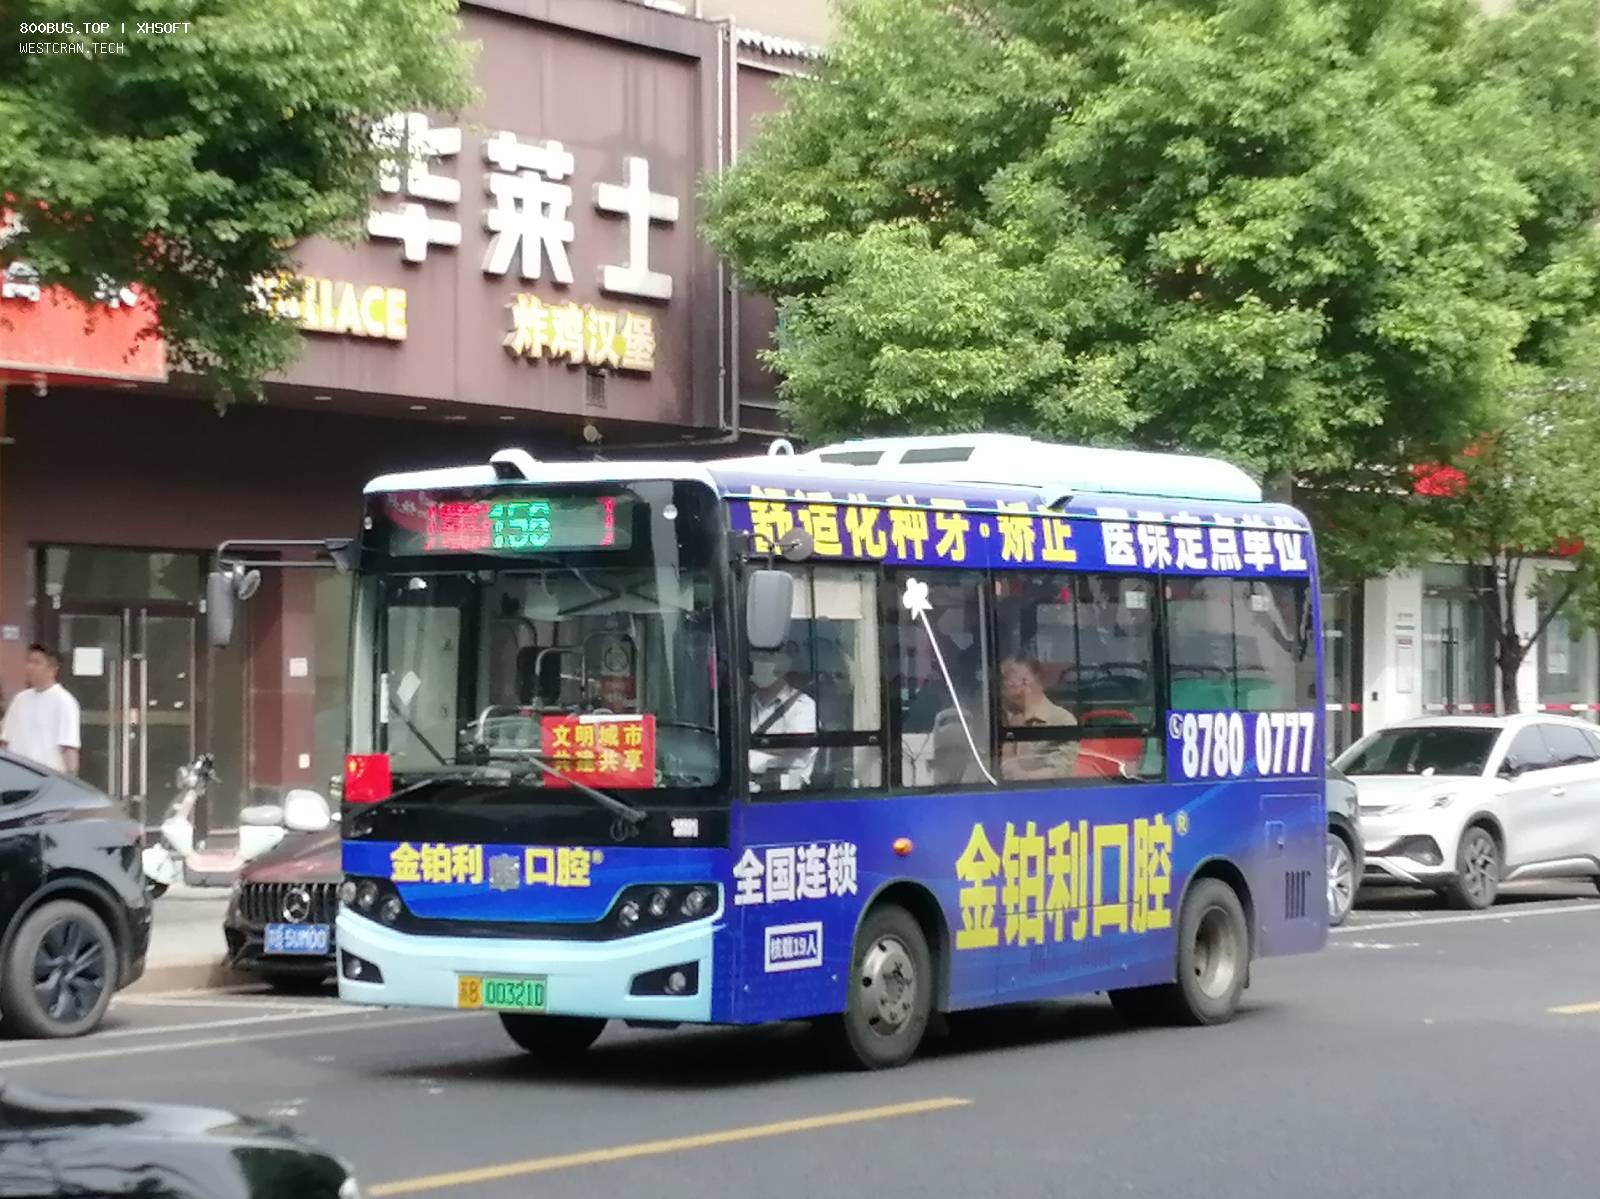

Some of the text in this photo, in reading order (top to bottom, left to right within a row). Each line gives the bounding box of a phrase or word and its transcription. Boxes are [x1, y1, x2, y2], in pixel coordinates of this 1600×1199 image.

[368, 111, 679, 300] 华莱士
[503, 292, 656, 371] 炸鸡汉堡
[1096, 507, 1307, 572] 医保定点单位
[552, 723, 643, 748] 文明城市
[1182, 712, 1315, 779] 8780 0777
[390, 841, 591, 887] 金铂利 口腔
[732, 841, 858, 906] 全国连锁
[955, 812, 1173, 950] 金铂利口腔
